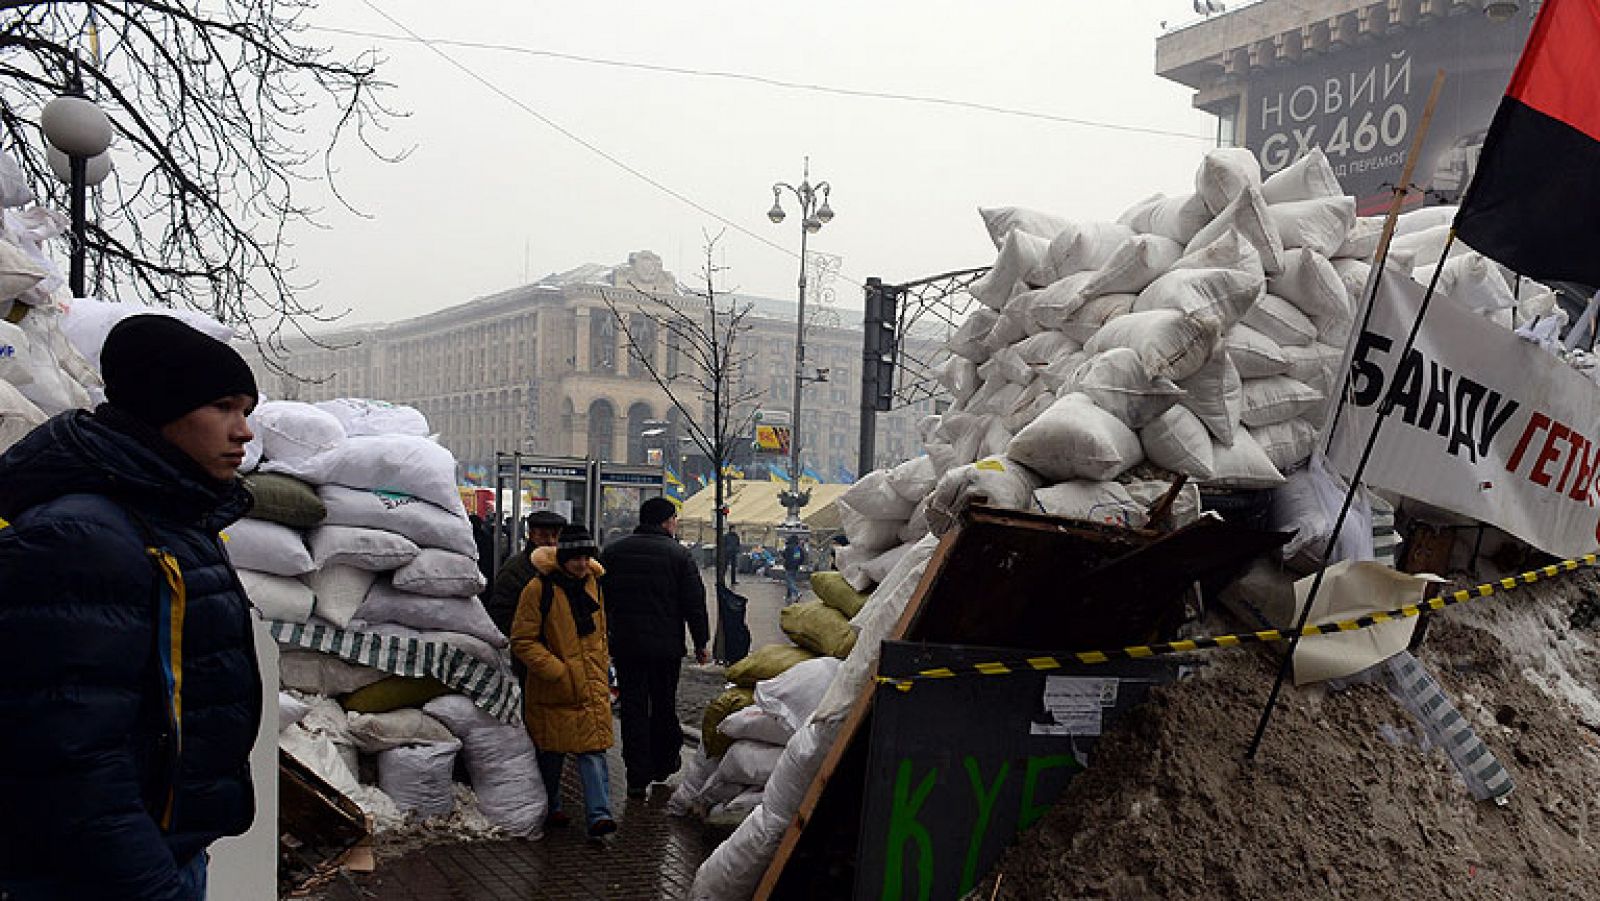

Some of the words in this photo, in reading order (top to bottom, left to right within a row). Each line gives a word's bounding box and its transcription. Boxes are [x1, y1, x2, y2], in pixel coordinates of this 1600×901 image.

[1261, 50, 1412, 130] НОВИЙ
[1260, 124, 1317, 172] GX
[1325, 103, 1408, 157] 460
[1350, 331, 1519, 464] БАНДУ
